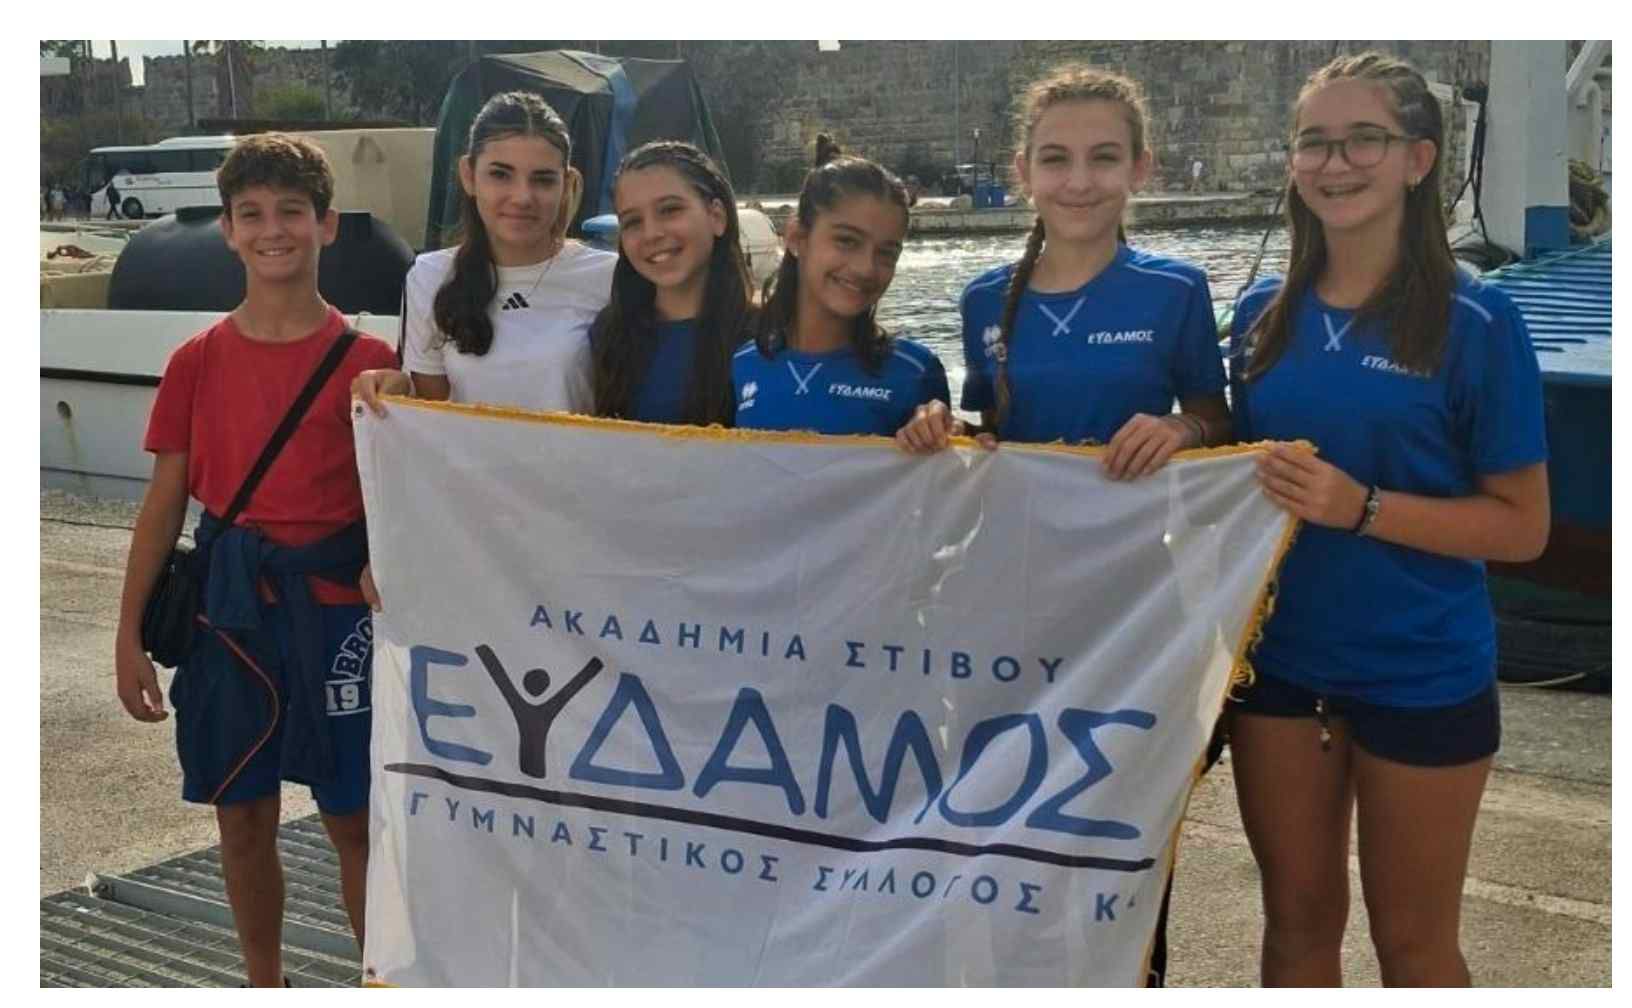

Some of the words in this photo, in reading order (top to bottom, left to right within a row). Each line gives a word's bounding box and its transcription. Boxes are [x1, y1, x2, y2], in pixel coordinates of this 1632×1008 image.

[529, 603, 808, 662] ΑΚΑΔΗΜΙΑ
[845, 638, 1066, 685] ΣΤΙΒΟΥ
[409, 642, 1157, 840] ΕΥΔΑΜΟΣ
[408, 789, 780, 883] ΓΥΜΝΑΣΤΙΚΟΣ
